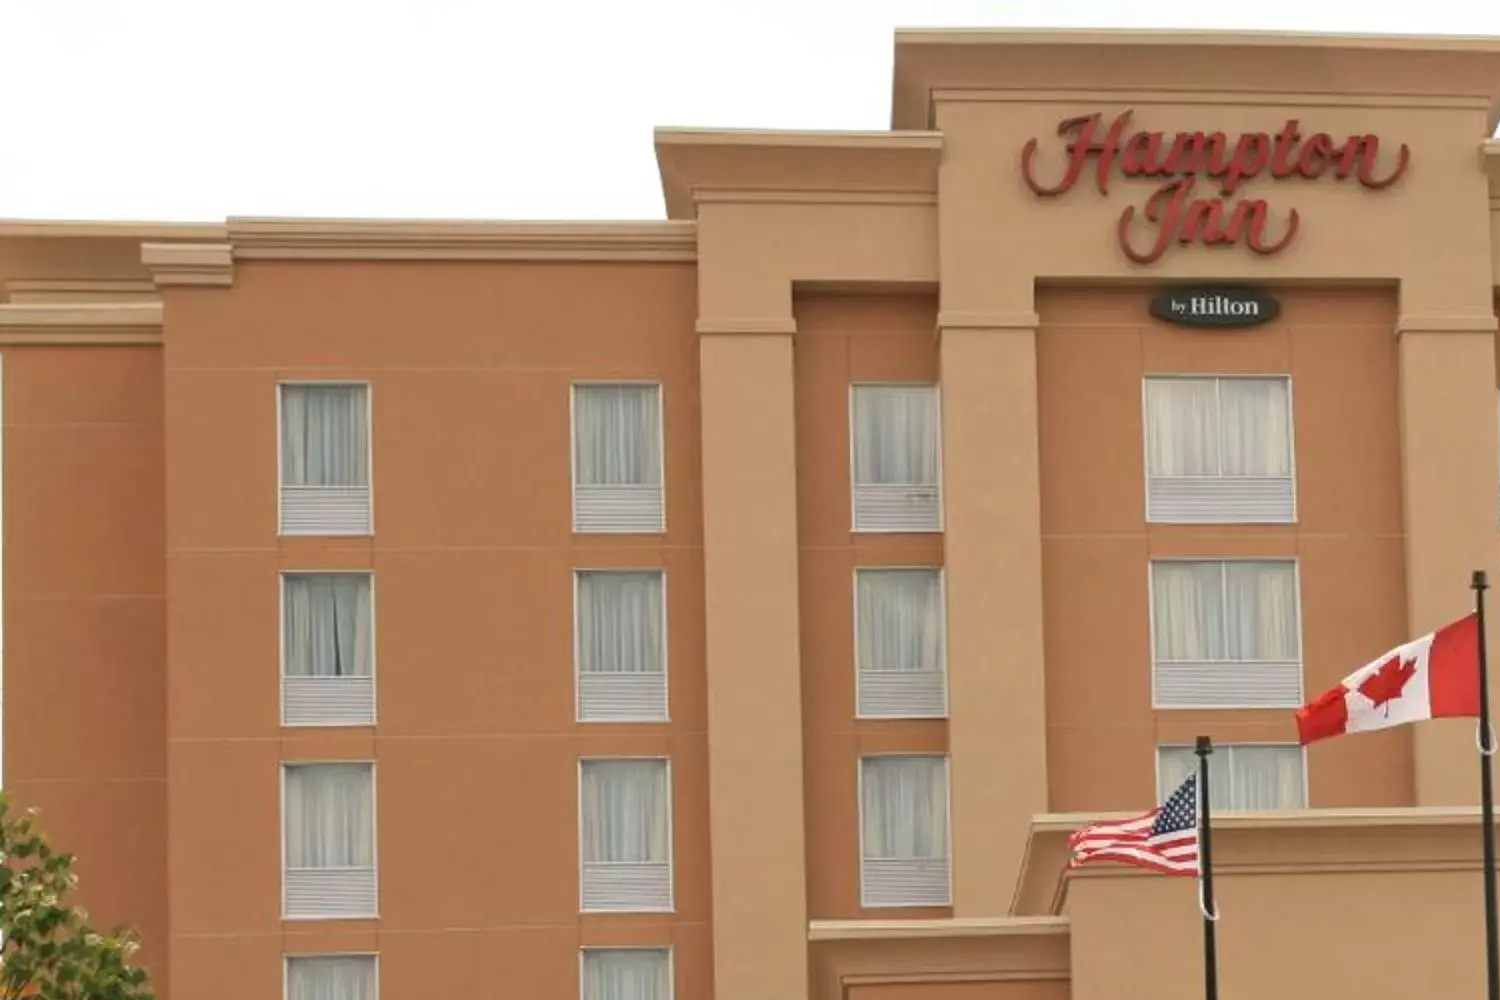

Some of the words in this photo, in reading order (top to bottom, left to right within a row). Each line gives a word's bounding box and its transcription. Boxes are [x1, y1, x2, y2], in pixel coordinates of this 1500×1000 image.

[1021, 108, 1411, 198] Hampton
[1117, 179, 1300, 264] Inn
[1171, 299, 1186, 315] by
[1190, 296, 1260, 316] Hilton
